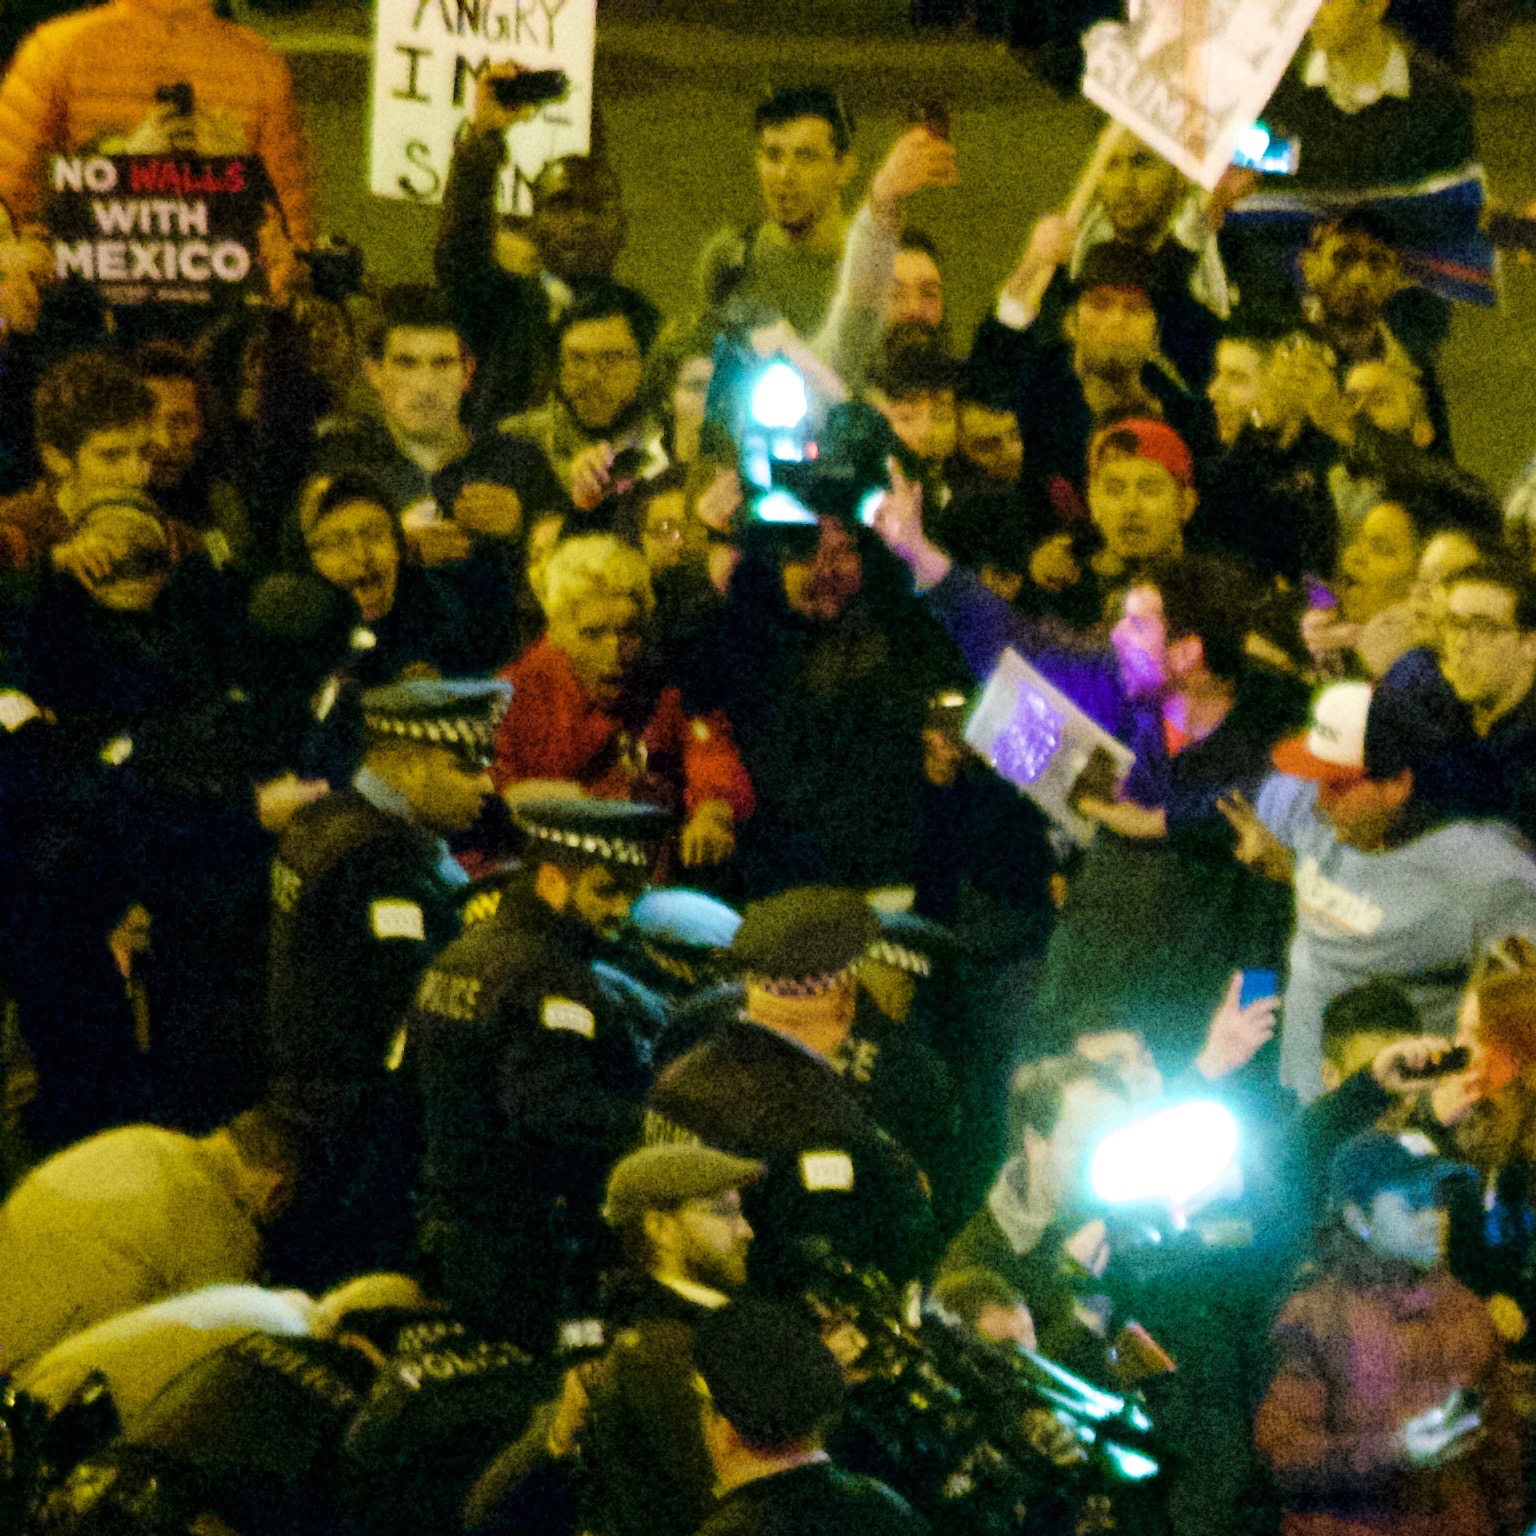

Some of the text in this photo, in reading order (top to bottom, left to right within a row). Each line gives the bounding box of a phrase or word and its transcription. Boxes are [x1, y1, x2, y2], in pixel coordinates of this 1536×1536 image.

[55, 156, 246, 197] NO WALLS
[92, 199, 208, 236] WITH
[55, 238, 250, 282] MEXICO
